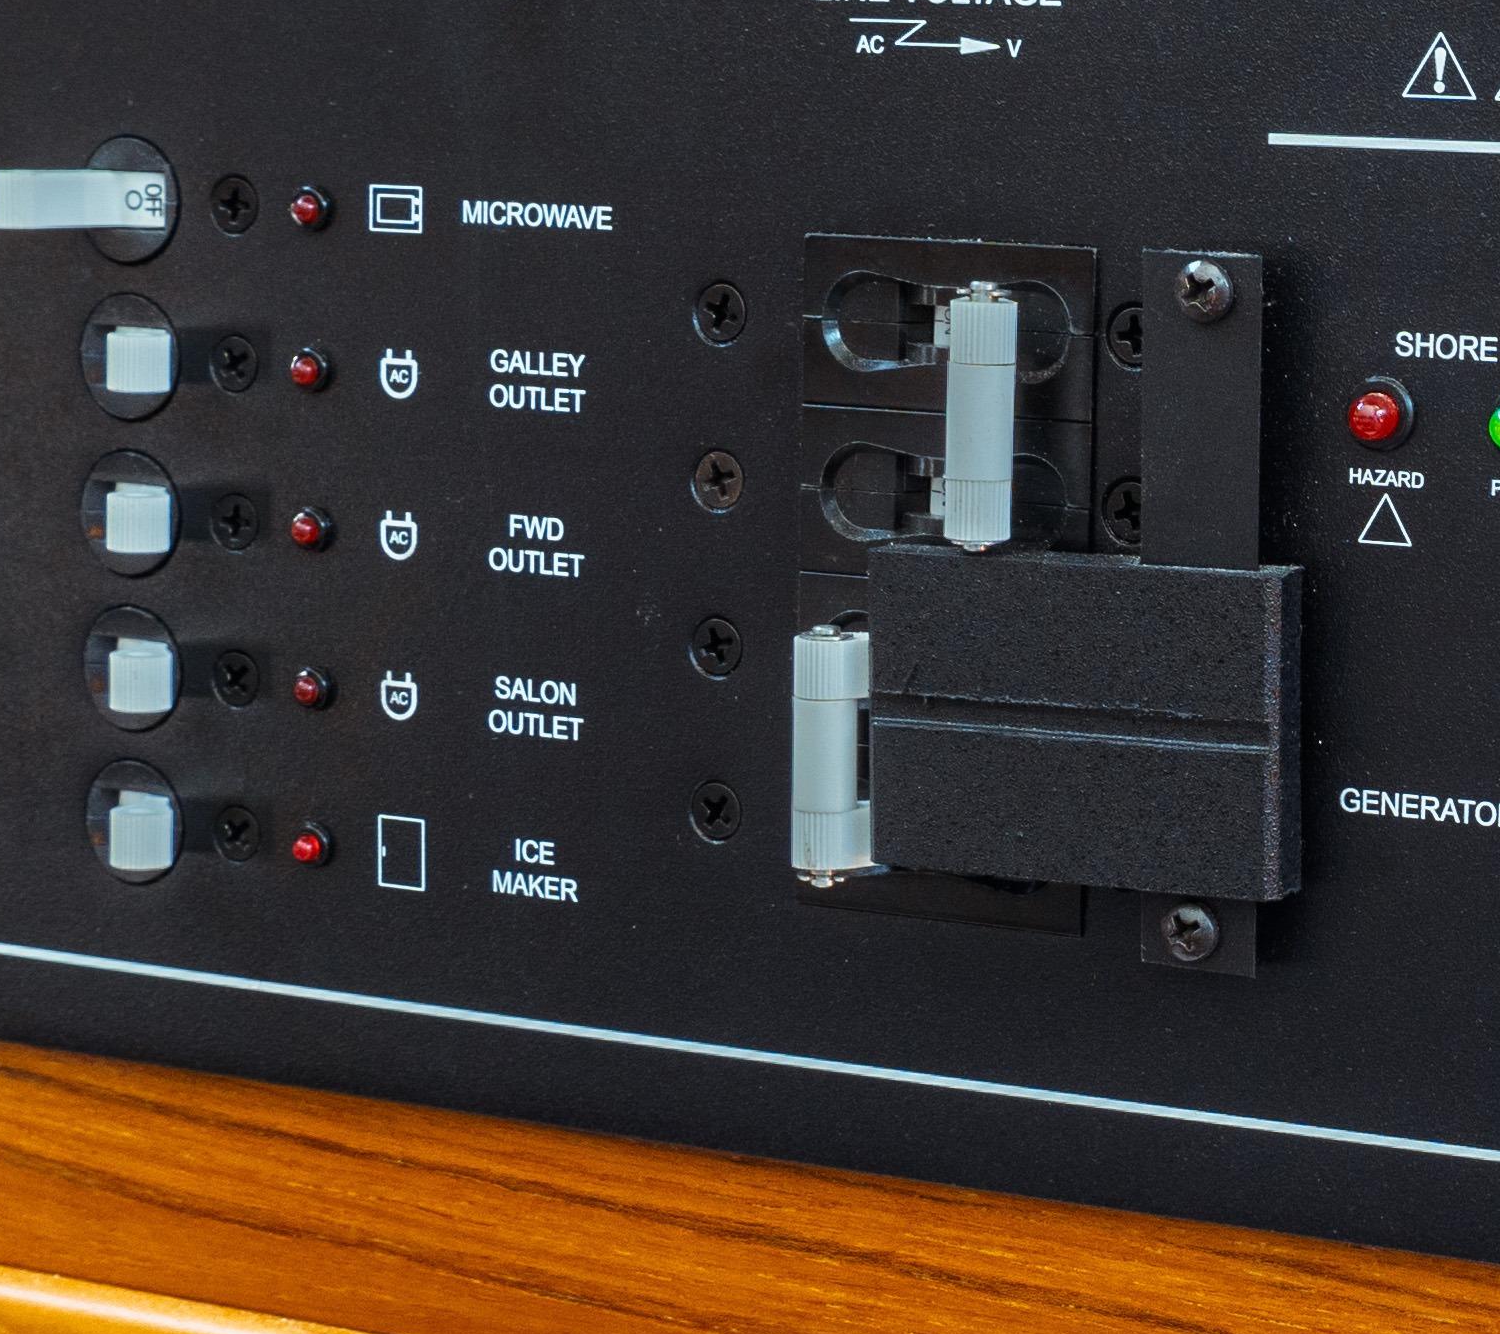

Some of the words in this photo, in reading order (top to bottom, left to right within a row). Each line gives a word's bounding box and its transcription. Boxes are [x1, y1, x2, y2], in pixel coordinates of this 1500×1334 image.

[855, 34, 885, 55] AC
[1006, 38, 1023, 58] V
[145, 184, 162, 217] OFF
[462, 199, 613, 231] MICROWAVE
[1394, 330, 1499, 363] SHORE
[389, 369, 409, 384] AC
[490, 348, 586, 378] GALLEY
[489, 383, 587, 413] OUTLET
[1348, 467, 1425, 489] HAZARD
[389, 530, 409, 545] AC
[509, 513, 565, 542] FWD
[488, 547, 586, 578] OUTLET
[389, 691, 409, 705] AC
[494, 675, 577, 707] SALON
[488, 709, 585, 741] OUTLET
[515, 838, 556, 866] ICE
[492, 869, 579, 903] MAKER
